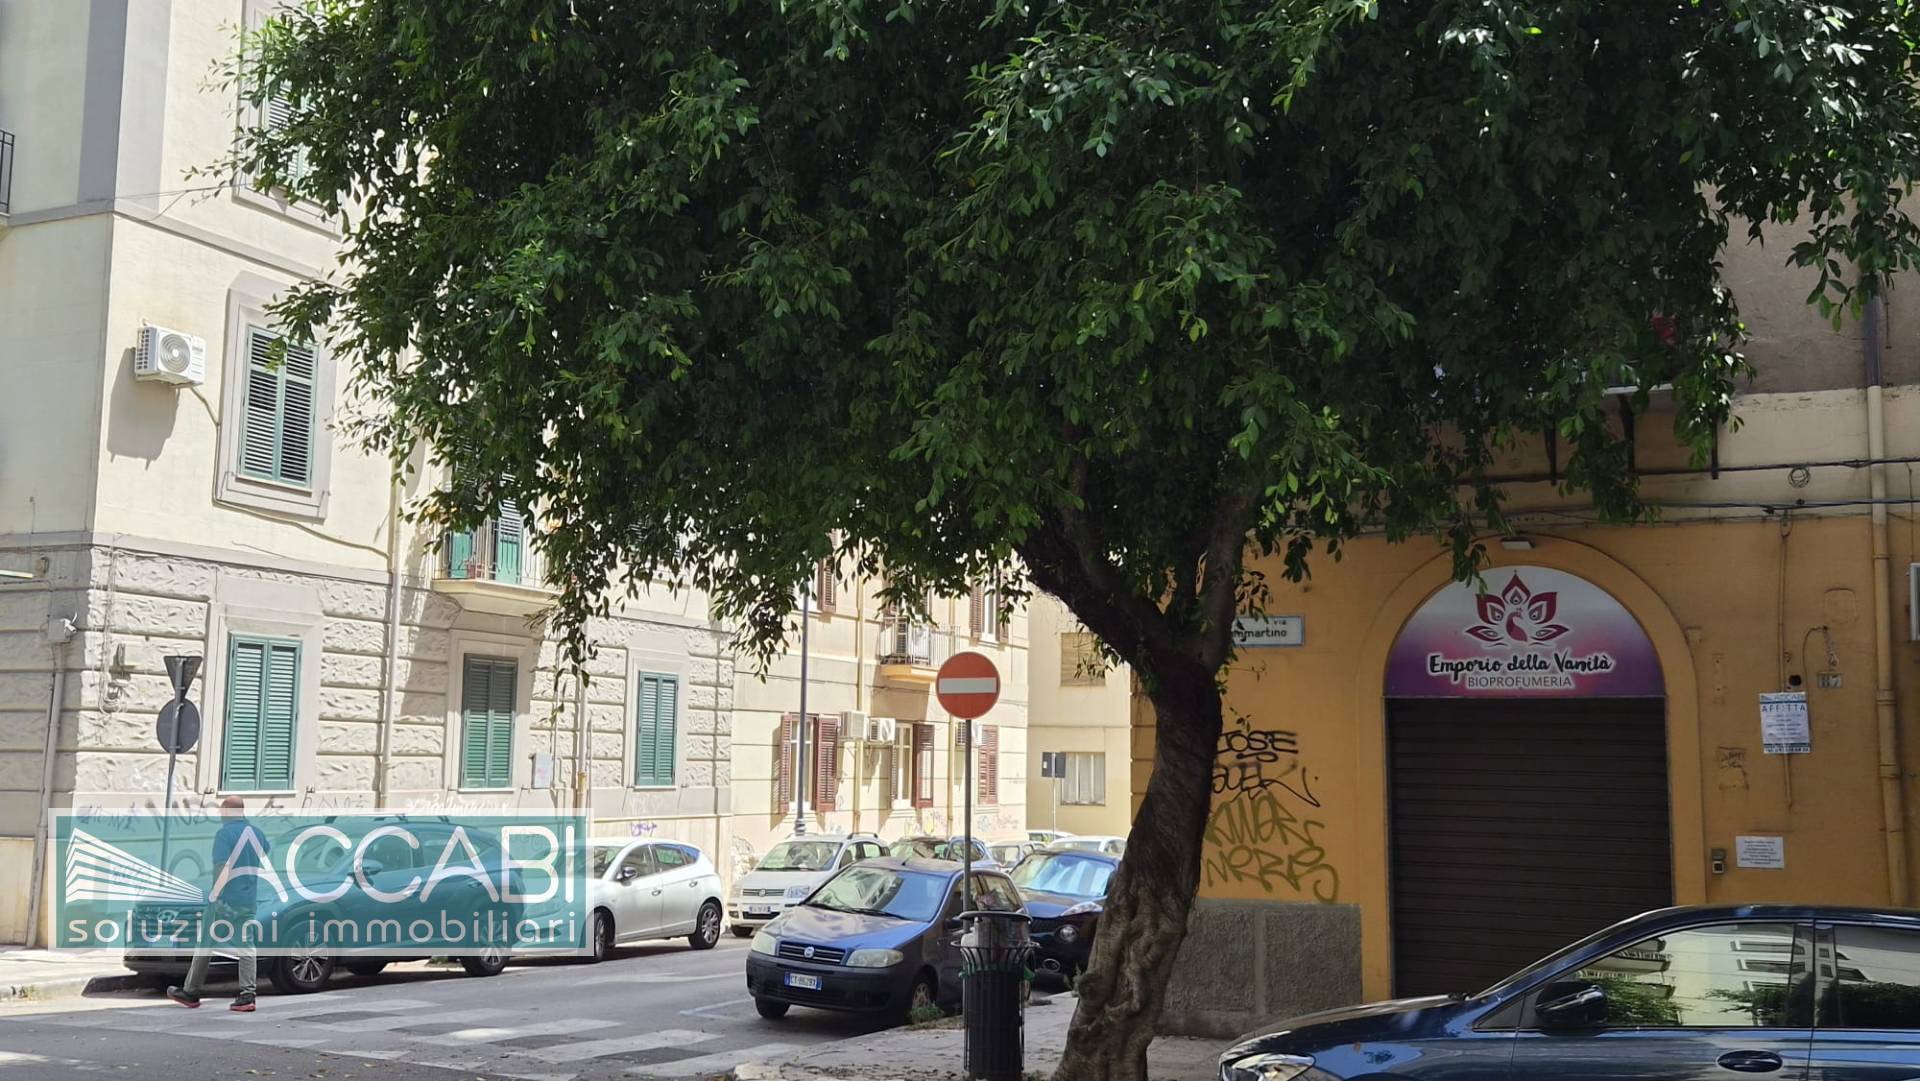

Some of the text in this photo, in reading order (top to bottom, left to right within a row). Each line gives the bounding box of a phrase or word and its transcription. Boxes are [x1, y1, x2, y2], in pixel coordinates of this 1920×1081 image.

[1429, 649, 1613, 682] Emporio della Vanità
[1467, 676, 1573, 689] BIOPROFUMERIA
